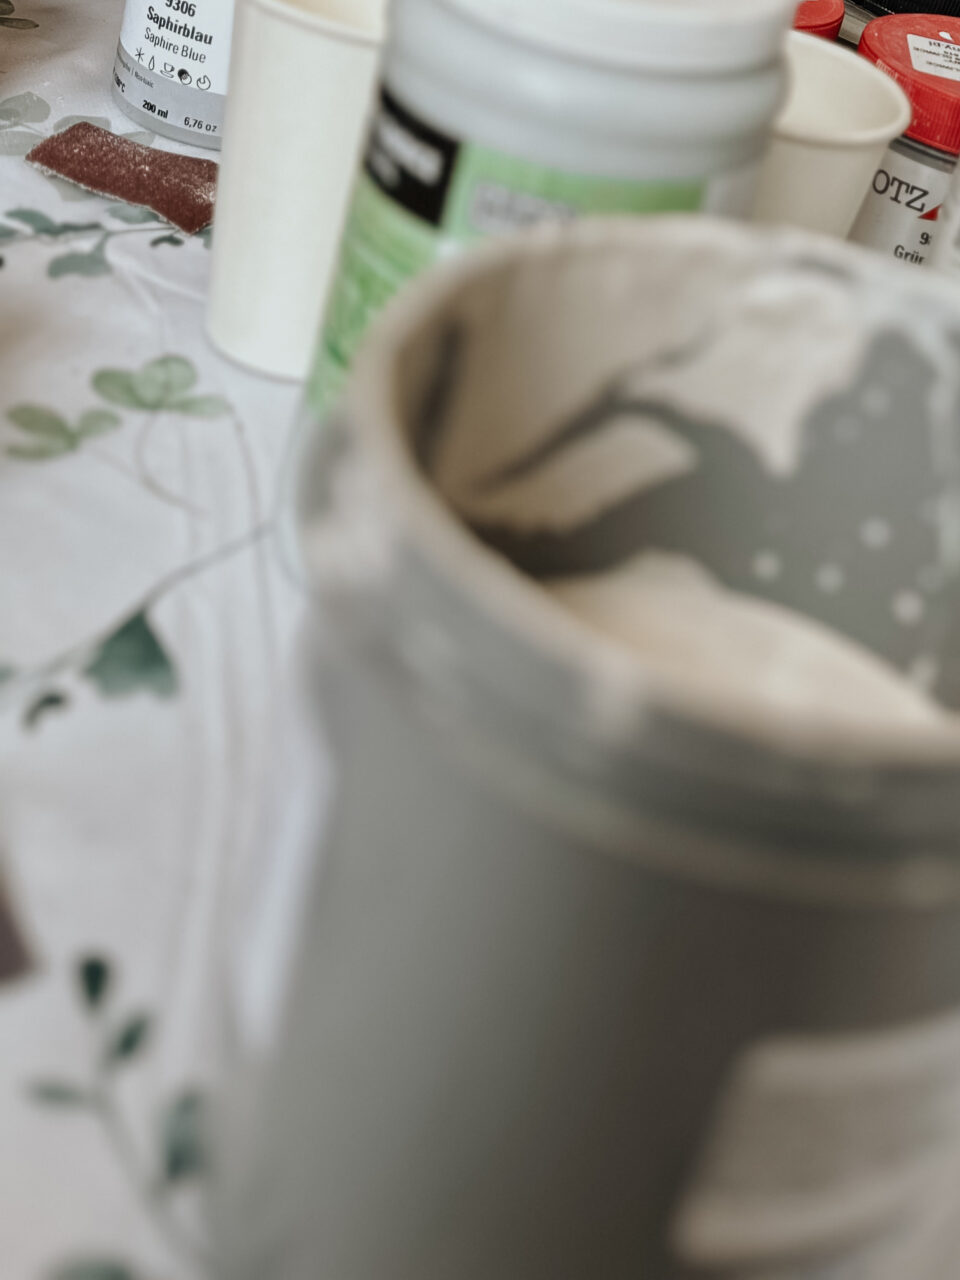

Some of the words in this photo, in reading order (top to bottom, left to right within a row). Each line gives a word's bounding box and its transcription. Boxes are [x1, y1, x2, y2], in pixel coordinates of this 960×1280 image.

[147, 6, 213, 45] Saphirblau
[144, 27, 179, 55] Saphire
[181, 45, 206, 64] Blue
[142, 99, 156, 114] 200
[157, 109, 169, 119] ml
[184, 117, 203, 130] 6,76
[205, 123, 217, 133] oz
[872, 168, 929, 213] OTZ
